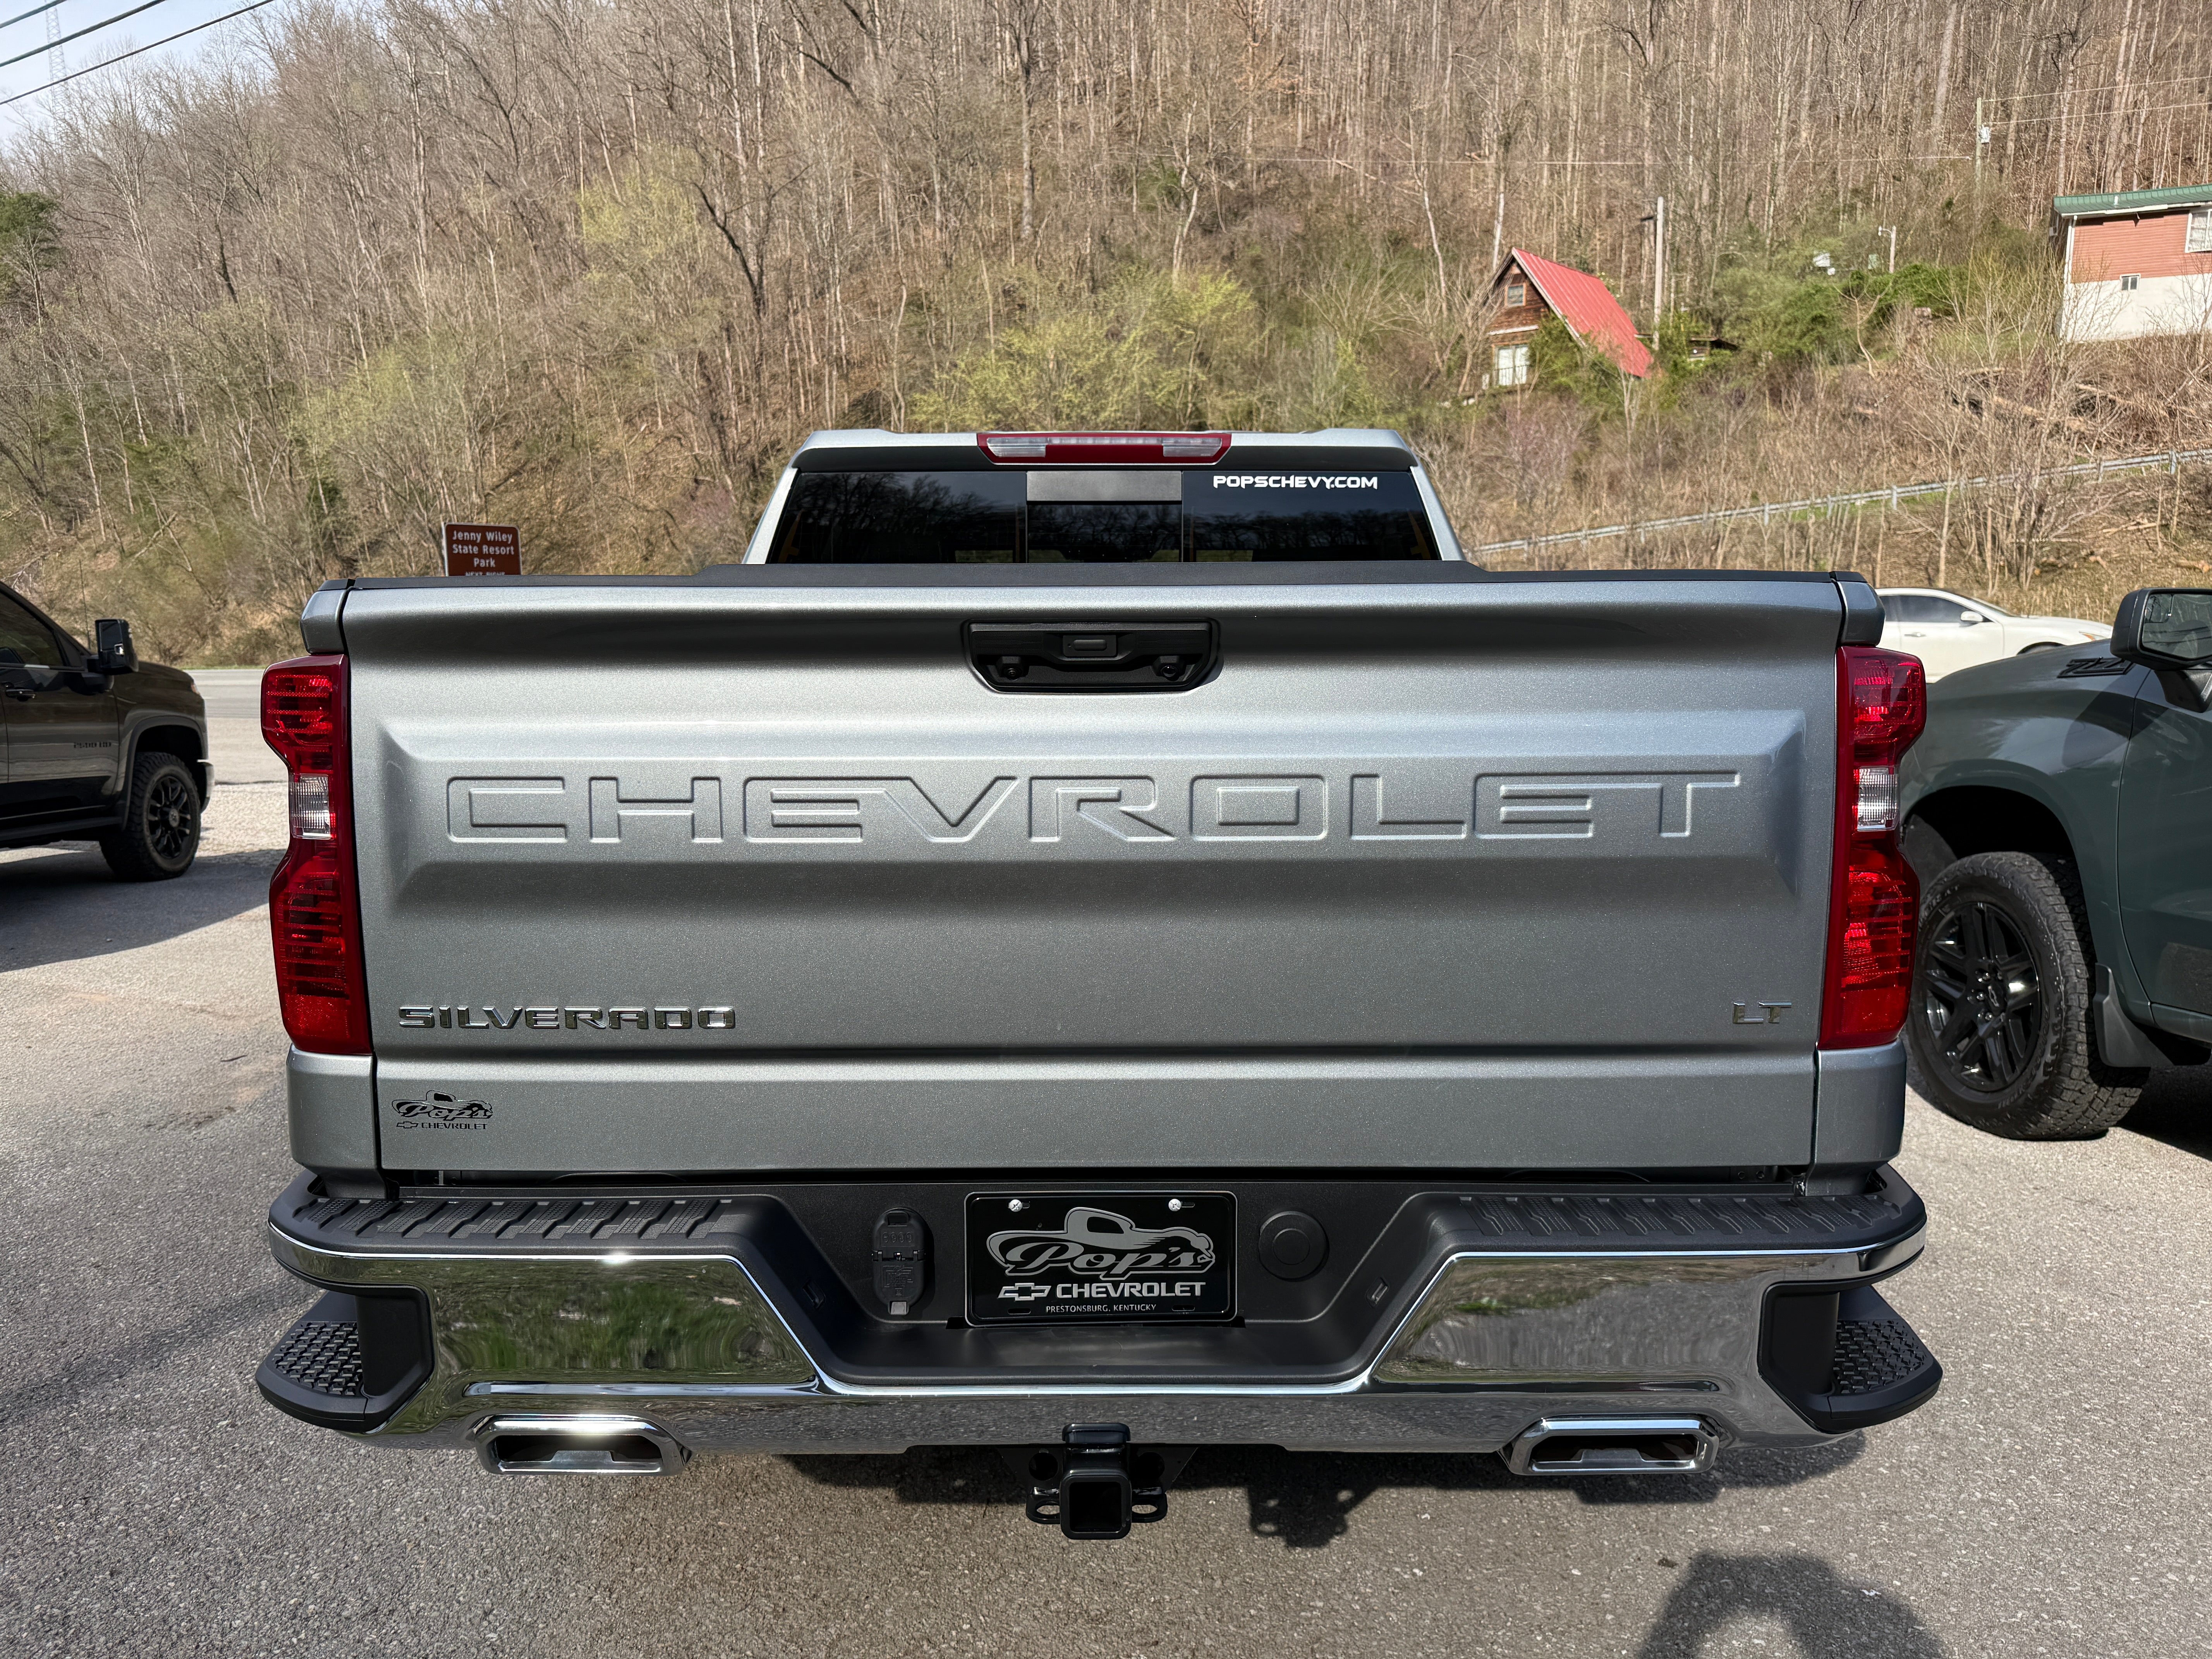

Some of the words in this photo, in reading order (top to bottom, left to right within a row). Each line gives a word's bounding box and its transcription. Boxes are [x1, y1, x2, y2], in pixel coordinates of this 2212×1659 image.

[1213, 475, 1378, 489] POPSCHEVY.COM
[452, 530, 481, 543] Jenny
[485, 531, 512, 544] Wiley
[452, 543, 479, 554] State
[483, 544, 514, 555] Resort
[474, 557, 496, 567] Park
[447, 769, 1740, 843] CHEVROLET
[398, 1005, 736, 1029] SILVERADO
[1731, 1001, 1792, 1024] LT
[1005, 1242, 1203, 1274] Pop's
[1056, 1282, 1206, 1298] CHEVROLET
[1113, 1304, 1156, 1312] KENTUCKY
